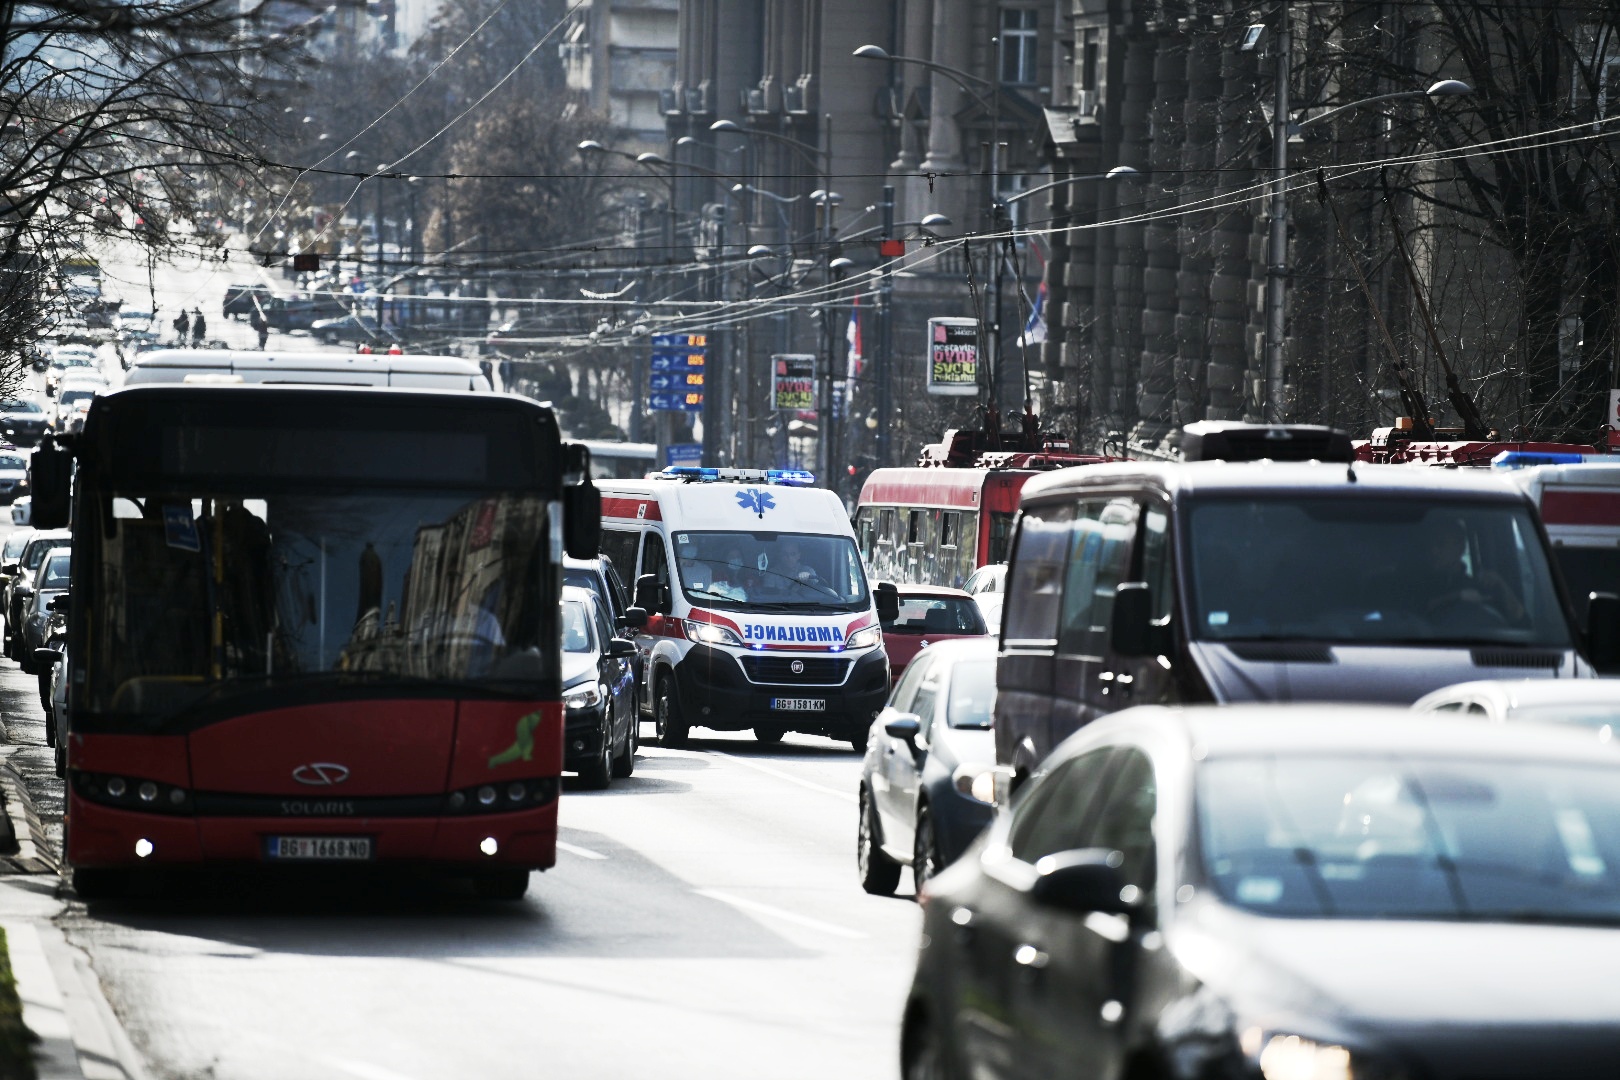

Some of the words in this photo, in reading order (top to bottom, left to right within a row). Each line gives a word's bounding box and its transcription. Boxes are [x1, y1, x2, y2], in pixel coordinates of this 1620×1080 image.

[934, 351, 976, 363] OVDE
[776, 700, 786, 709] BG
[281, 801, 354, 815] SOLARIS
[280, 840, 298, 855] BG
